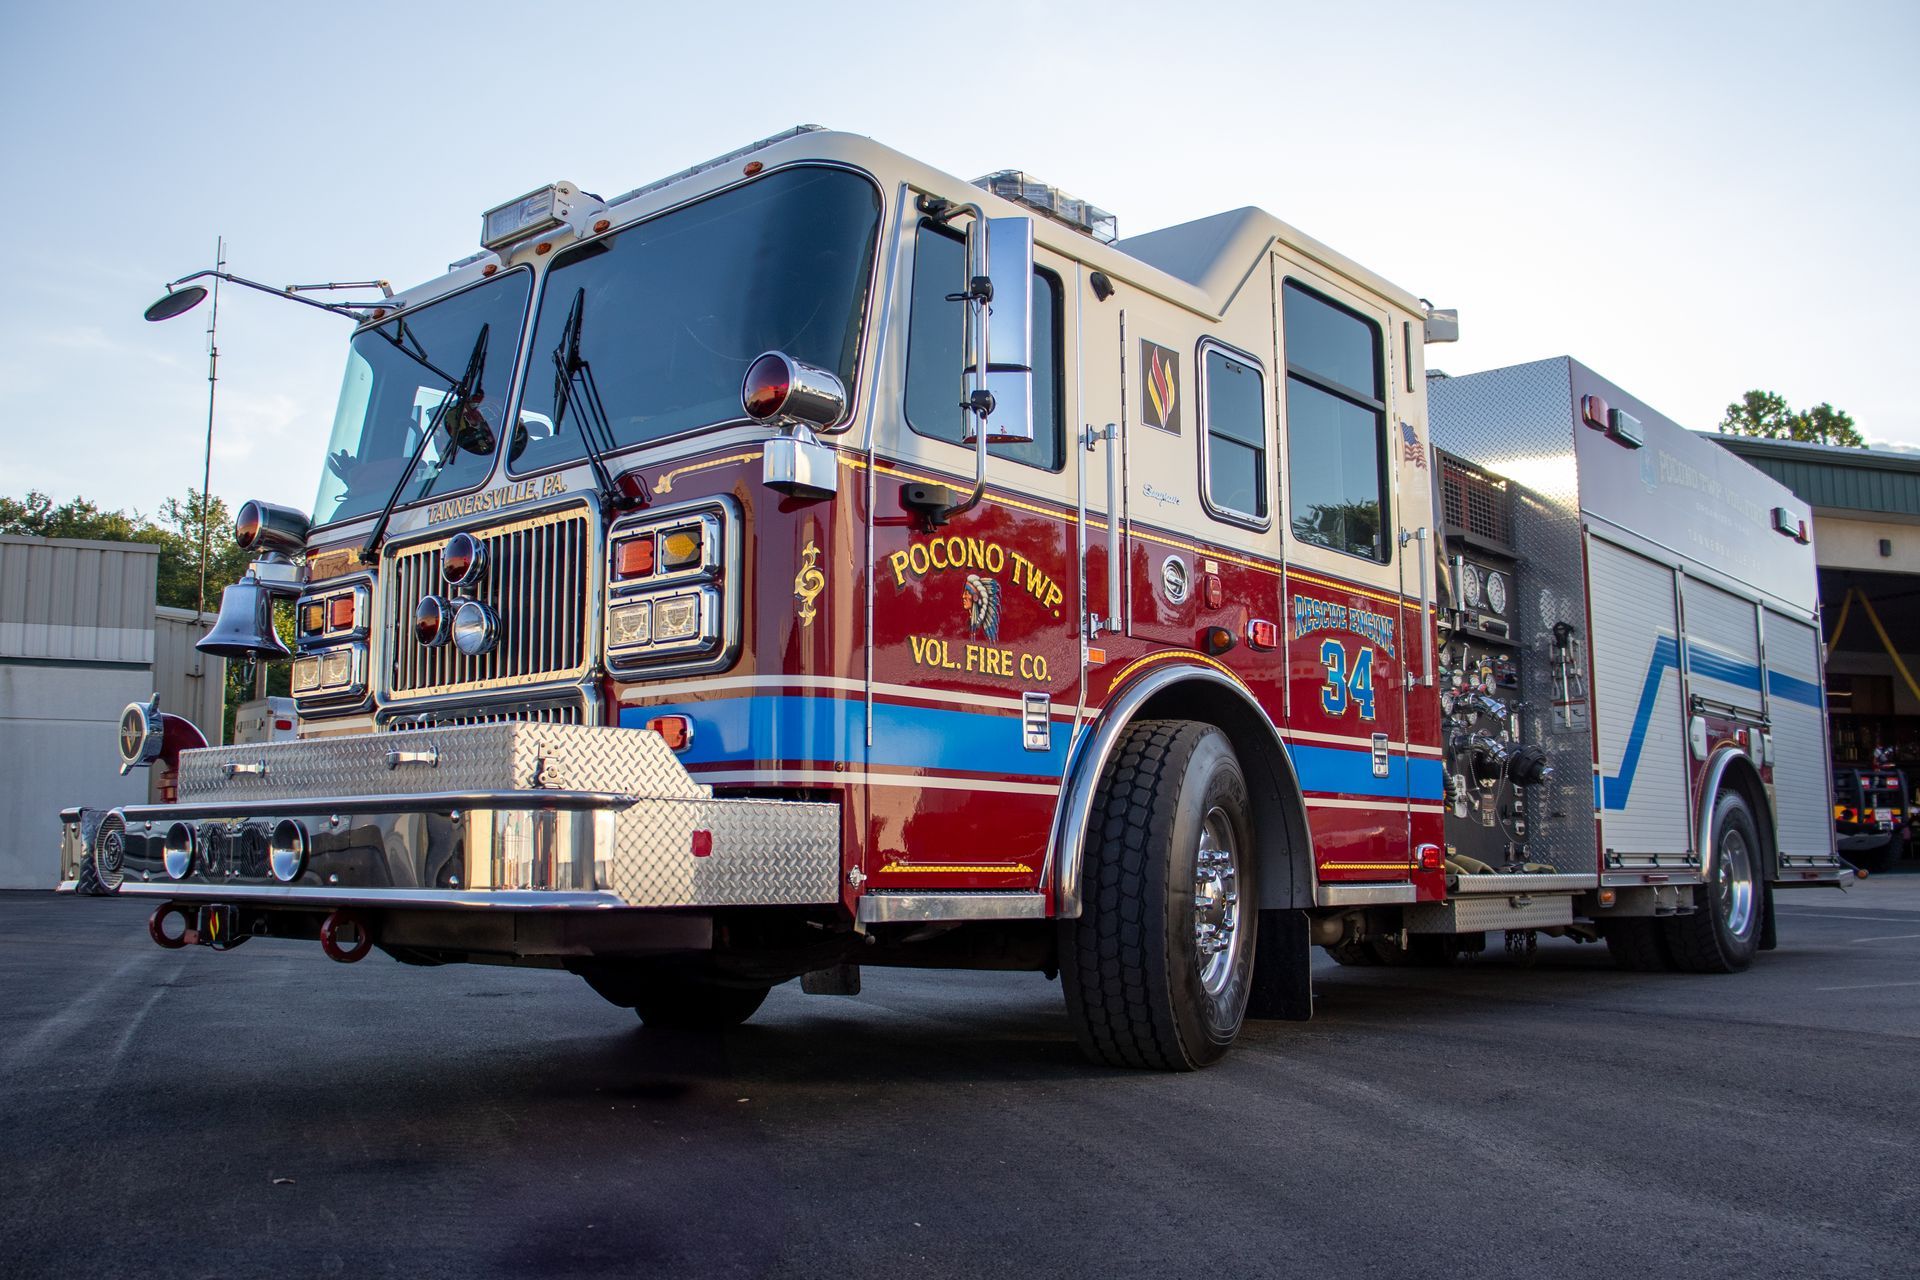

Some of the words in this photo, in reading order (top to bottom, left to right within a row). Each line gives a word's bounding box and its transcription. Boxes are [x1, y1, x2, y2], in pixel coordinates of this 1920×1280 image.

[542, 473, 567, 498] PA.
[890, 536, 1005, 586] POCONO
[1010, 552, 1063, 617] TWP.
[909, 635, 961, 670] VOL.
[966, 644, 1014, 677] FIRE
[1020, 653, 1052, 682] CO.
[1294, 594, 1347, 640] RESCUE
[1349, 608, 1395, 660] ENGINE
[1320, 638, 1376, 721] 34
